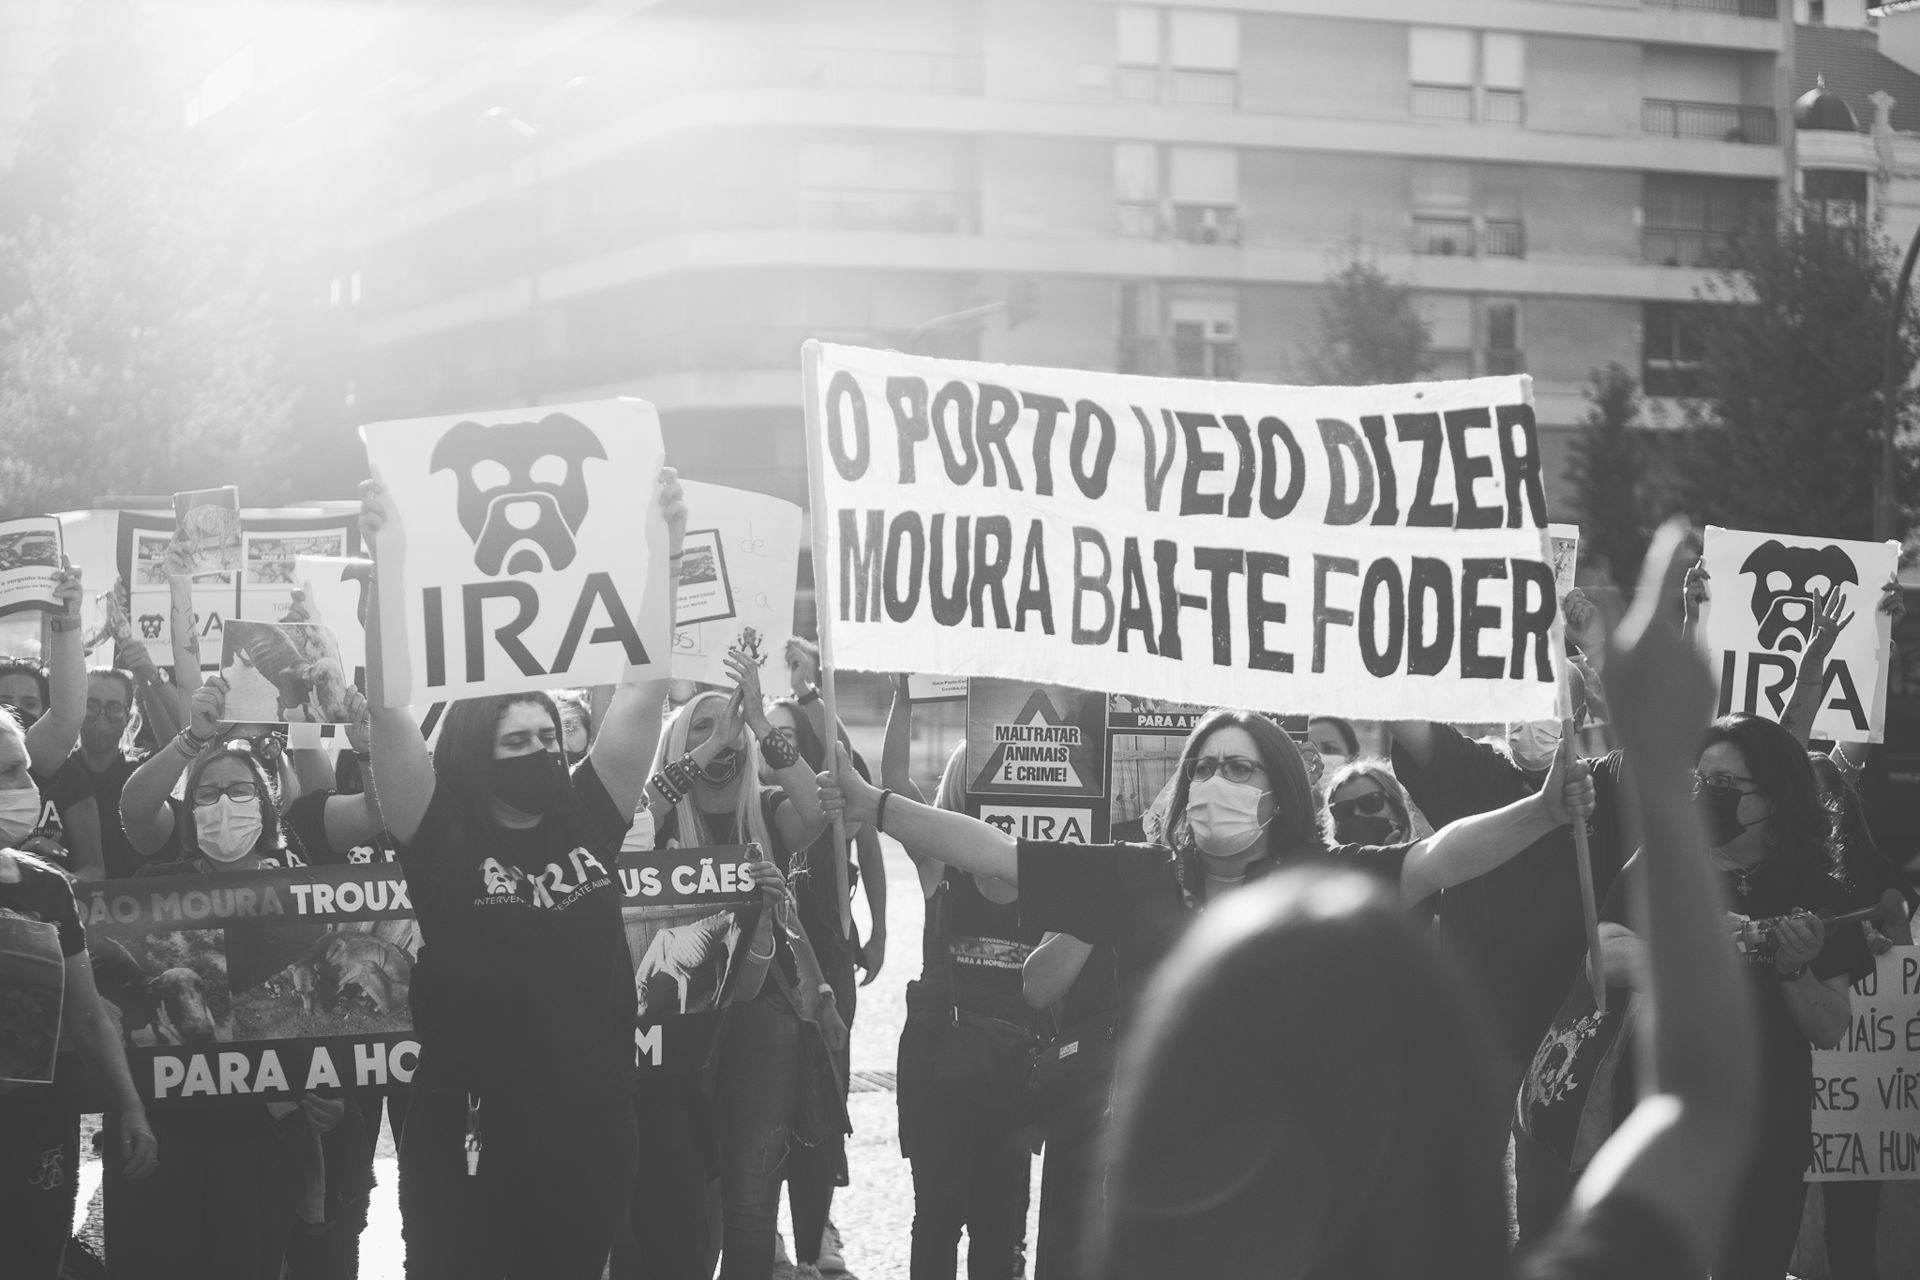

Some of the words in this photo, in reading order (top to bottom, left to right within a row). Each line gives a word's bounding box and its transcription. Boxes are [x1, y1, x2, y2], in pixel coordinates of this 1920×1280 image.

[826, 370, 870, 482] O
[886, 376, 1116, 500] PORTO
[1130, 405, 1306, 520] VEIO
[1315, 403, 1549, 530] DIZER
[838, 509, 1055, 636] MOURA
[1071, 526, 1294, 674] BAI-TE
[1311, 553, 1557, 683] FODER
[422, 571, 652, 688] IRA
[1716, 650, 1871, 732] IRA
[995, 725, 1079, 744] MALTRATAR
[1137, 714, 1174, 727] PARA
[1176, 715, 1187, 728] A
[1004, 762, 1012, 781] É
[1016, 765, 1067, 783] CRIME!
[1005, 746, 1068, 763] ANIMAIS
[1021, 815, 1087, 844] IRA
[150, 886, 286, 923] MOURA
[671, 857, 756, 895] CÃES
[153, 1049, 291, 1099] PARA
[304, 1045, 343, 1090] A
